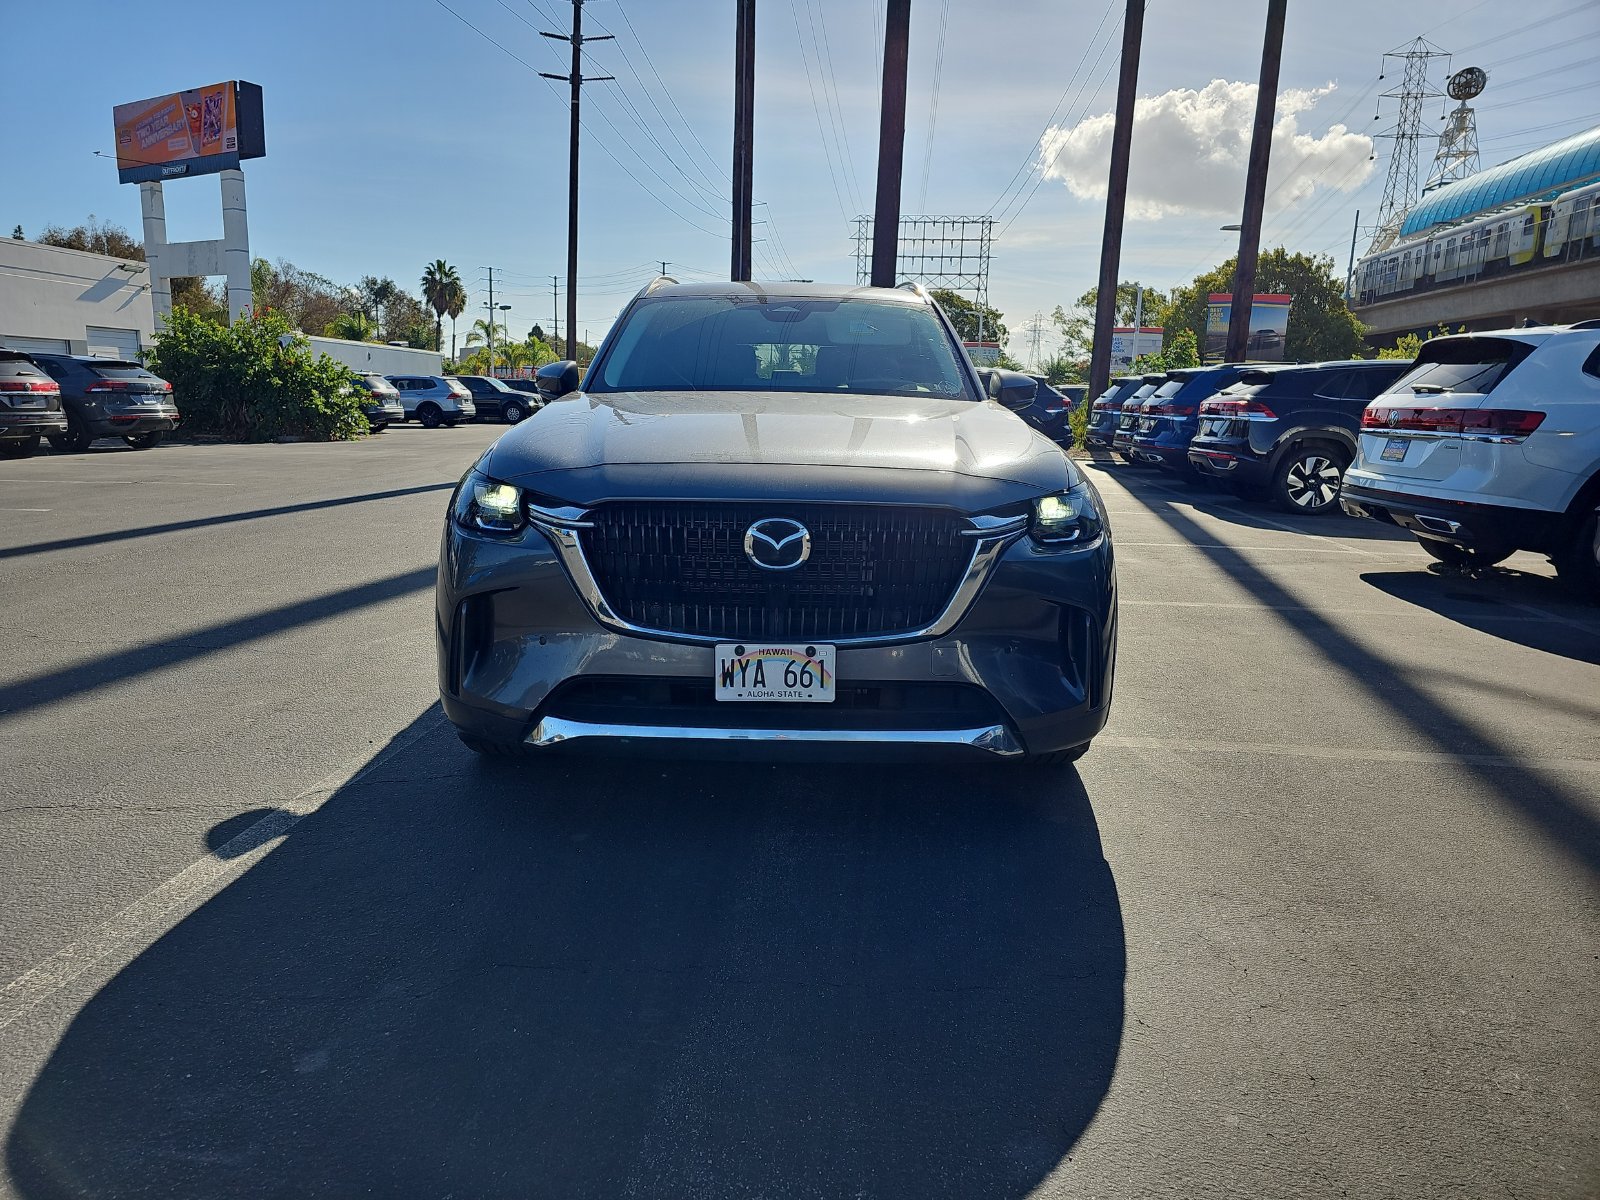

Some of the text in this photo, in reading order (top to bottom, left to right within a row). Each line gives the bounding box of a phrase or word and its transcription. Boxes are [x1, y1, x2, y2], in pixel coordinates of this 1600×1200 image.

[152, 116, 169, 132] YEAR
[141, 117, 186, 150] ANNIVERSARY
[758, 648, 793, 656] HAWAII
[721, 658, 825, 689] WYA 661
[746, 690, 803, 698] ALOHA STATE
